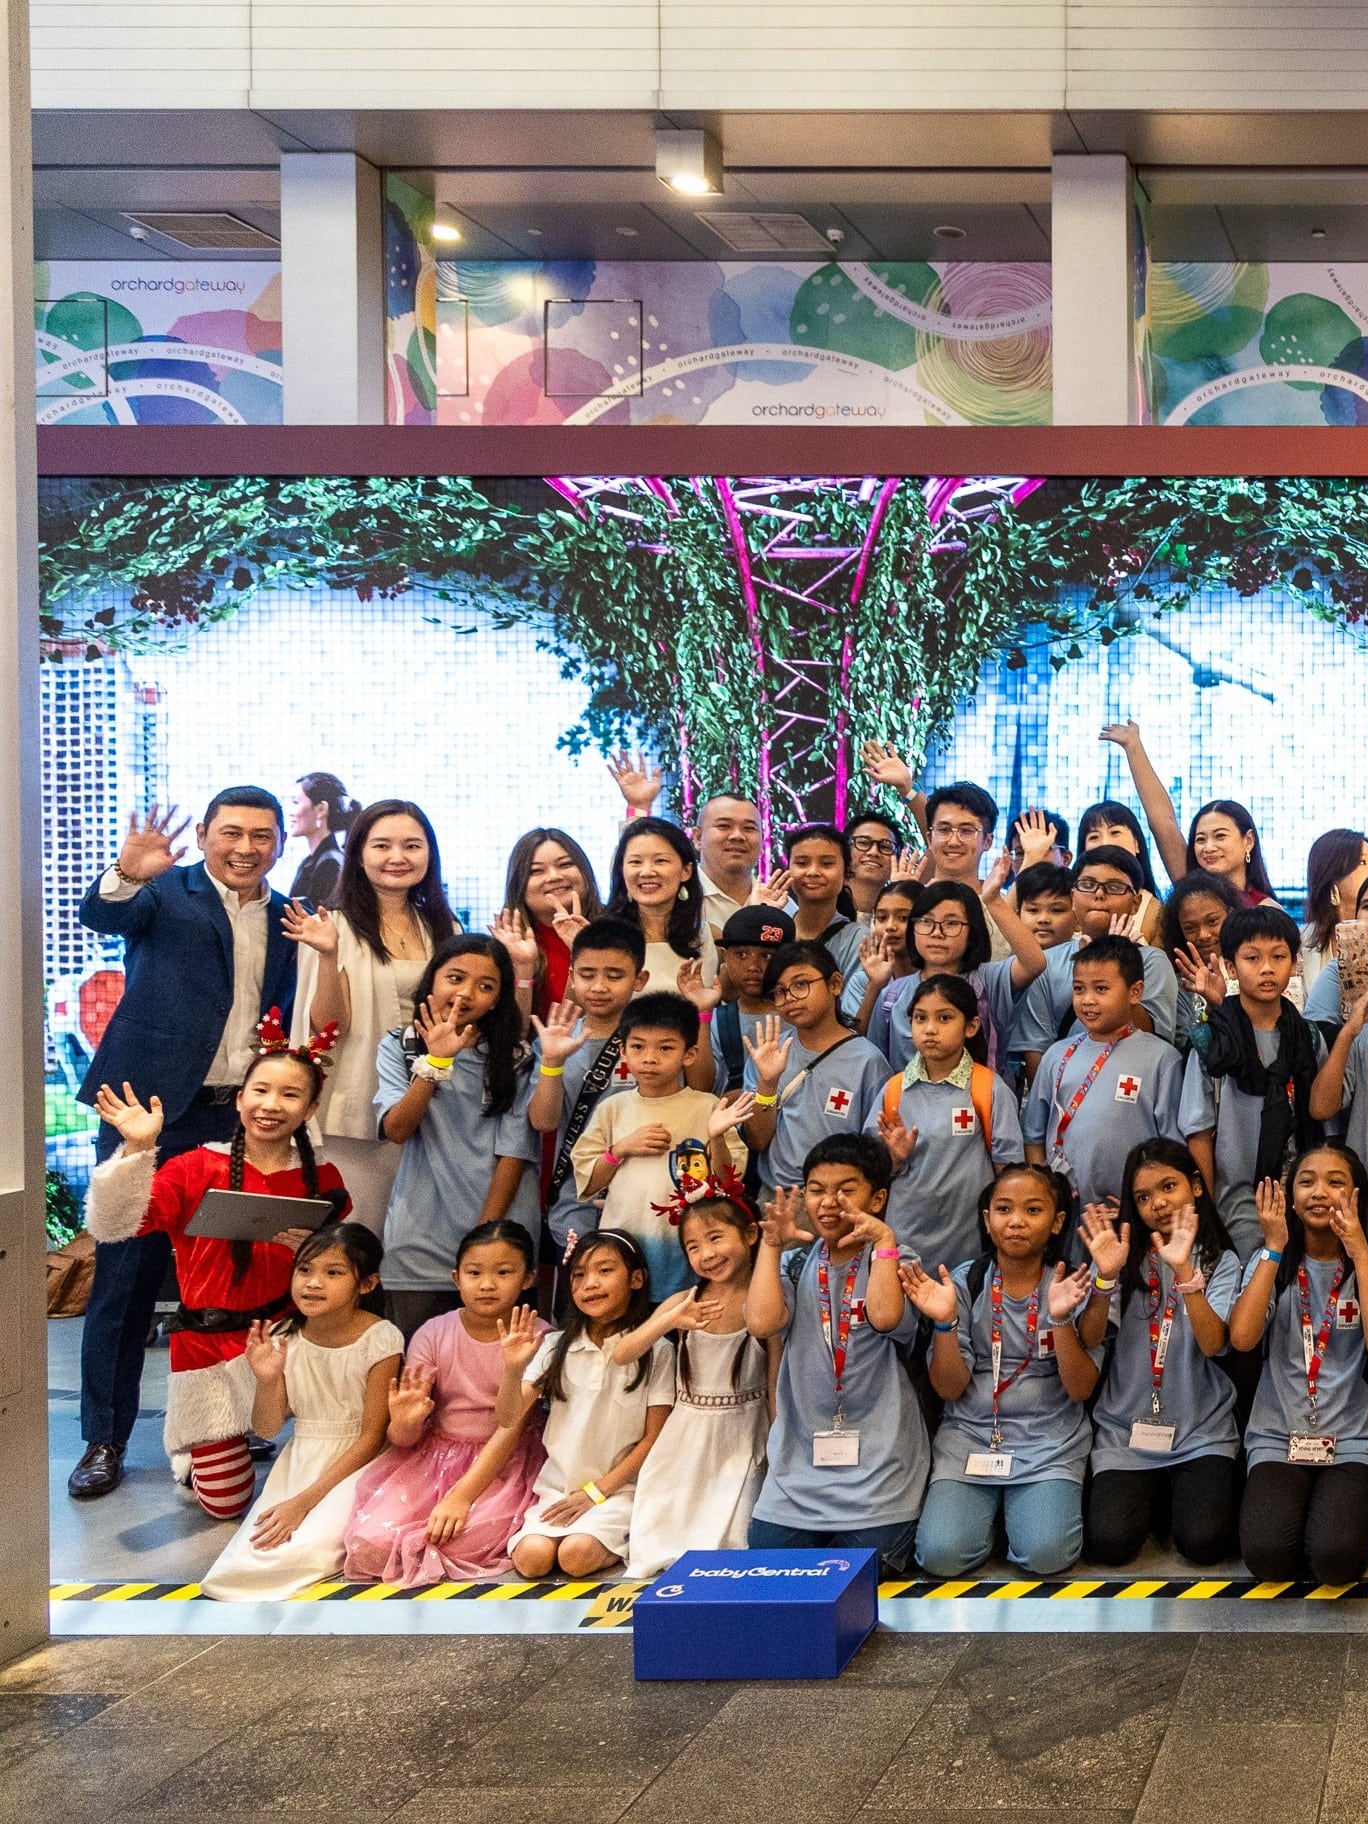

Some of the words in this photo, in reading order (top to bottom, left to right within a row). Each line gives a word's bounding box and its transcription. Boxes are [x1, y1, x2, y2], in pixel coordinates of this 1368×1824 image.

[111, 277, 246, 294] orchardgateway
[951, 316, 1026, 331] orchardgateway
[166, 347, 246, 365] orchardgateway
[677, 348, 755, 368] orchardgateway
[782, 348, 859, 370] orchardgateway
[1195, 370, 1291, 402] orchardgateway
[752, 402, 886, 420] orchardgateway
[761, 925, 784, 942] 23
[592, 1036, 622, 1081] GUES
[689, 1566, 829, 1579] babyCentral
